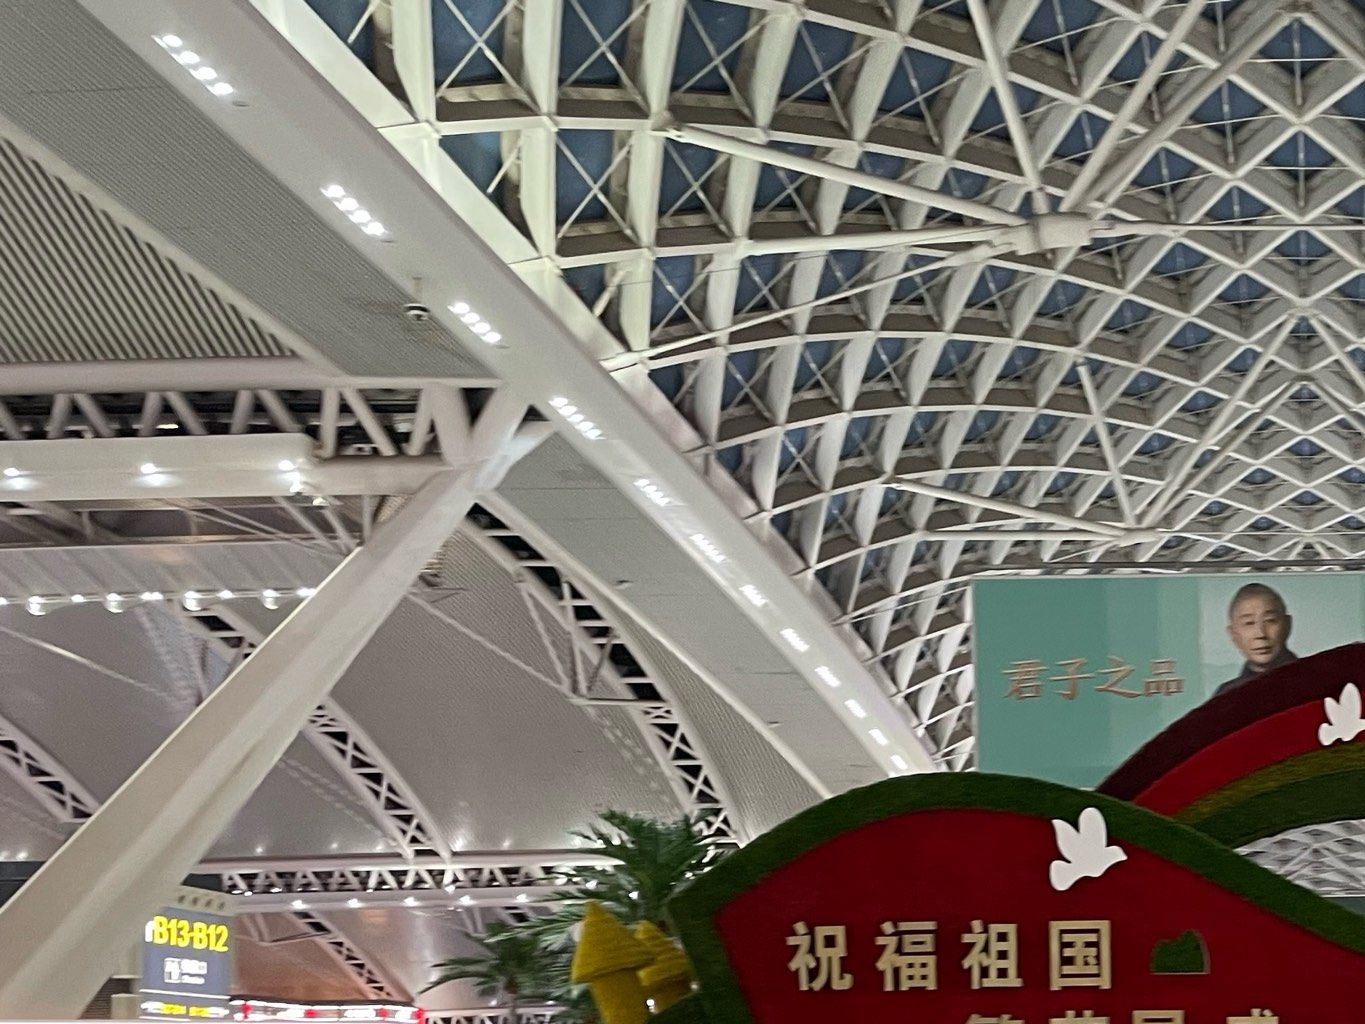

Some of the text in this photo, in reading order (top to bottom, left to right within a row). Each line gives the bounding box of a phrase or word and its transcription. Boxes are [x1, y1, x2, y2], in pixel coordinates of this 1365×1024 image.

[1001, 655, 1185, 700] 君子之品
[153, 915, 229, 952] B13-B12
[786, 919, 1112, 991] 祝福祖国
